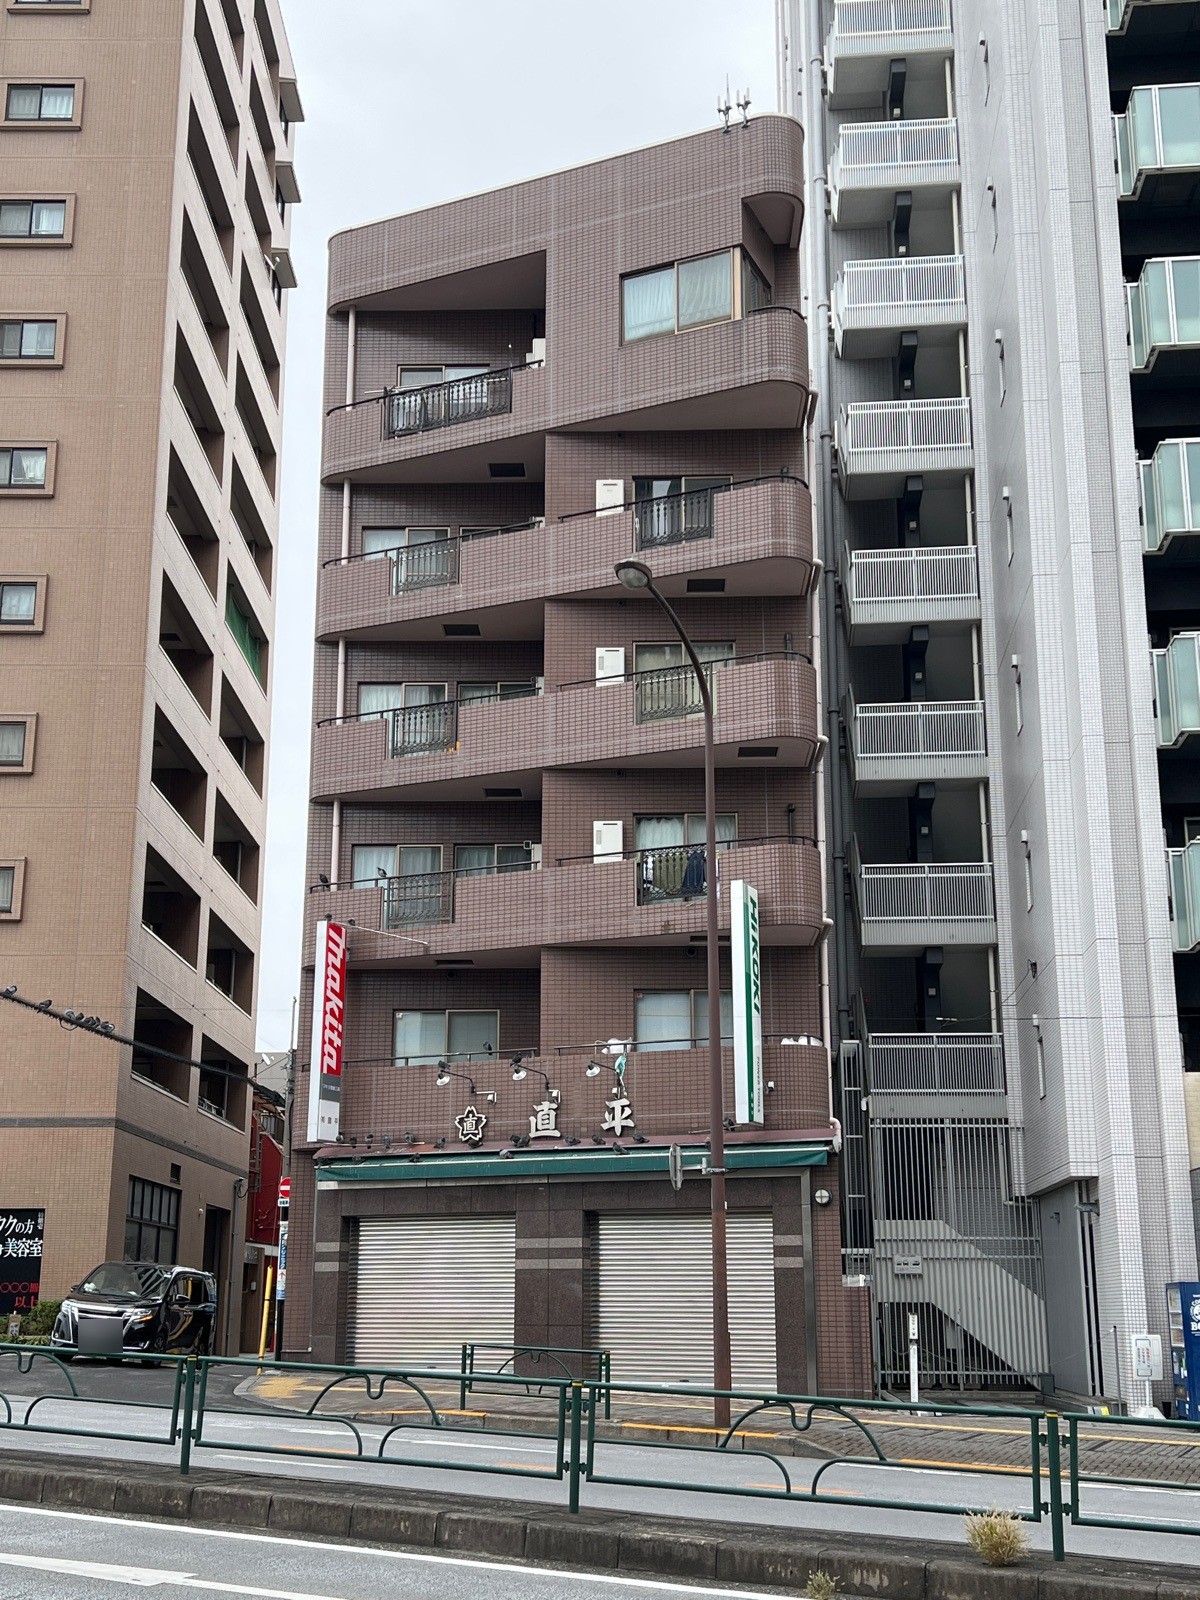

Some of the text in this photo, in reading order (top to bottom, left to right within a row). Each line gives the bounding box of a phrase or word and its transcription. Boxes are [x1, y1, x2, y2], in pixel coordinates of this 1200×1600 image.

[529, 1098, 635, 1140] 直平
[0, 1238, 43, 1258] 美容室
